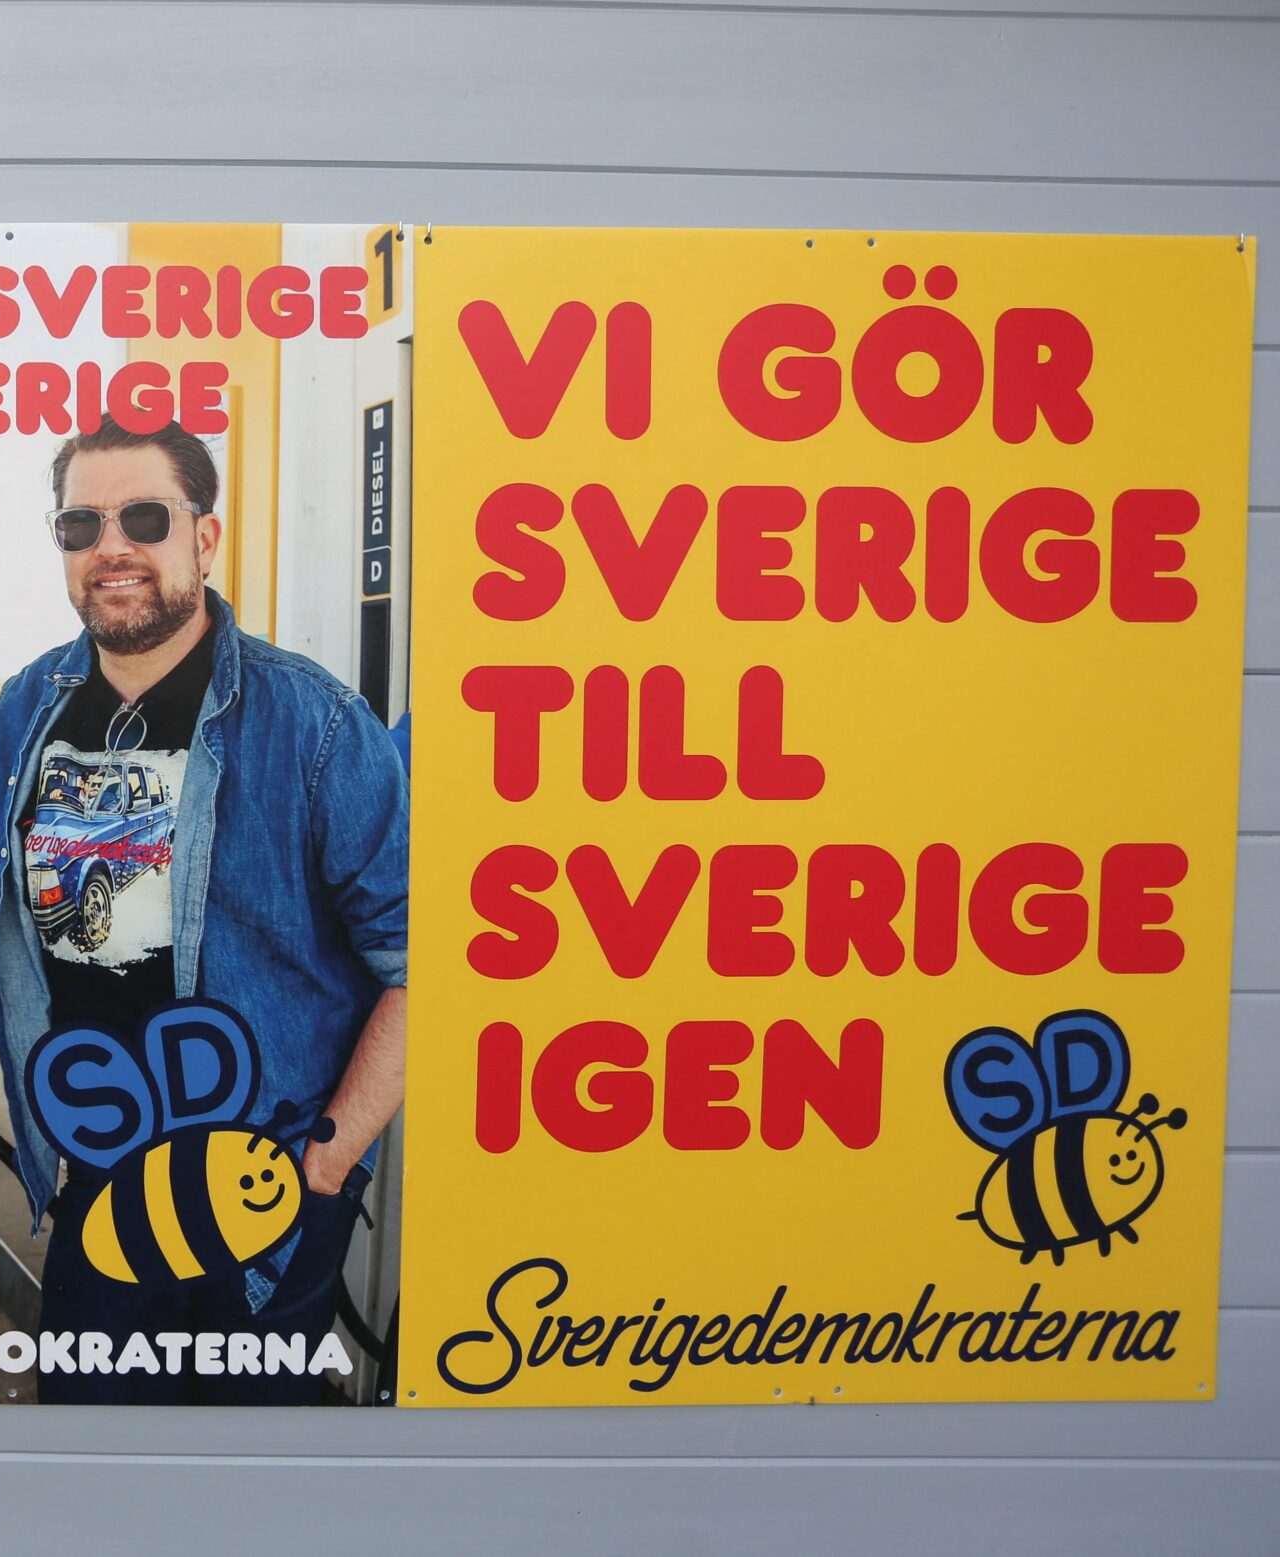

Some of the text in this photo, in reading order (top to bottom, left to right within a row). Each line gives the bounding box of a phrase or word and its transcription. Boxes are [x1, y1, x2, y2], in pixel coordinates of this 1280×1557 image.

[374, 229, 393, 312] 1
[457, 265, 1094, 445] VI GÖR
[371, 441, 384, 535] DIESEL
[472, 483, 1201, 623] SVERIGE
[371, 561, 383, 582] D
[461, 665, 826, 802] TILL
[466, 842, 1189, 980] SVERIGE
[48, 1021, 238, 1150] SD
[475, 1018, 885, 1154] IGEN
[963, 1029, 1112, 1133] SD
[436, 1258, 1180, 1394] Sverigedemokraterna
